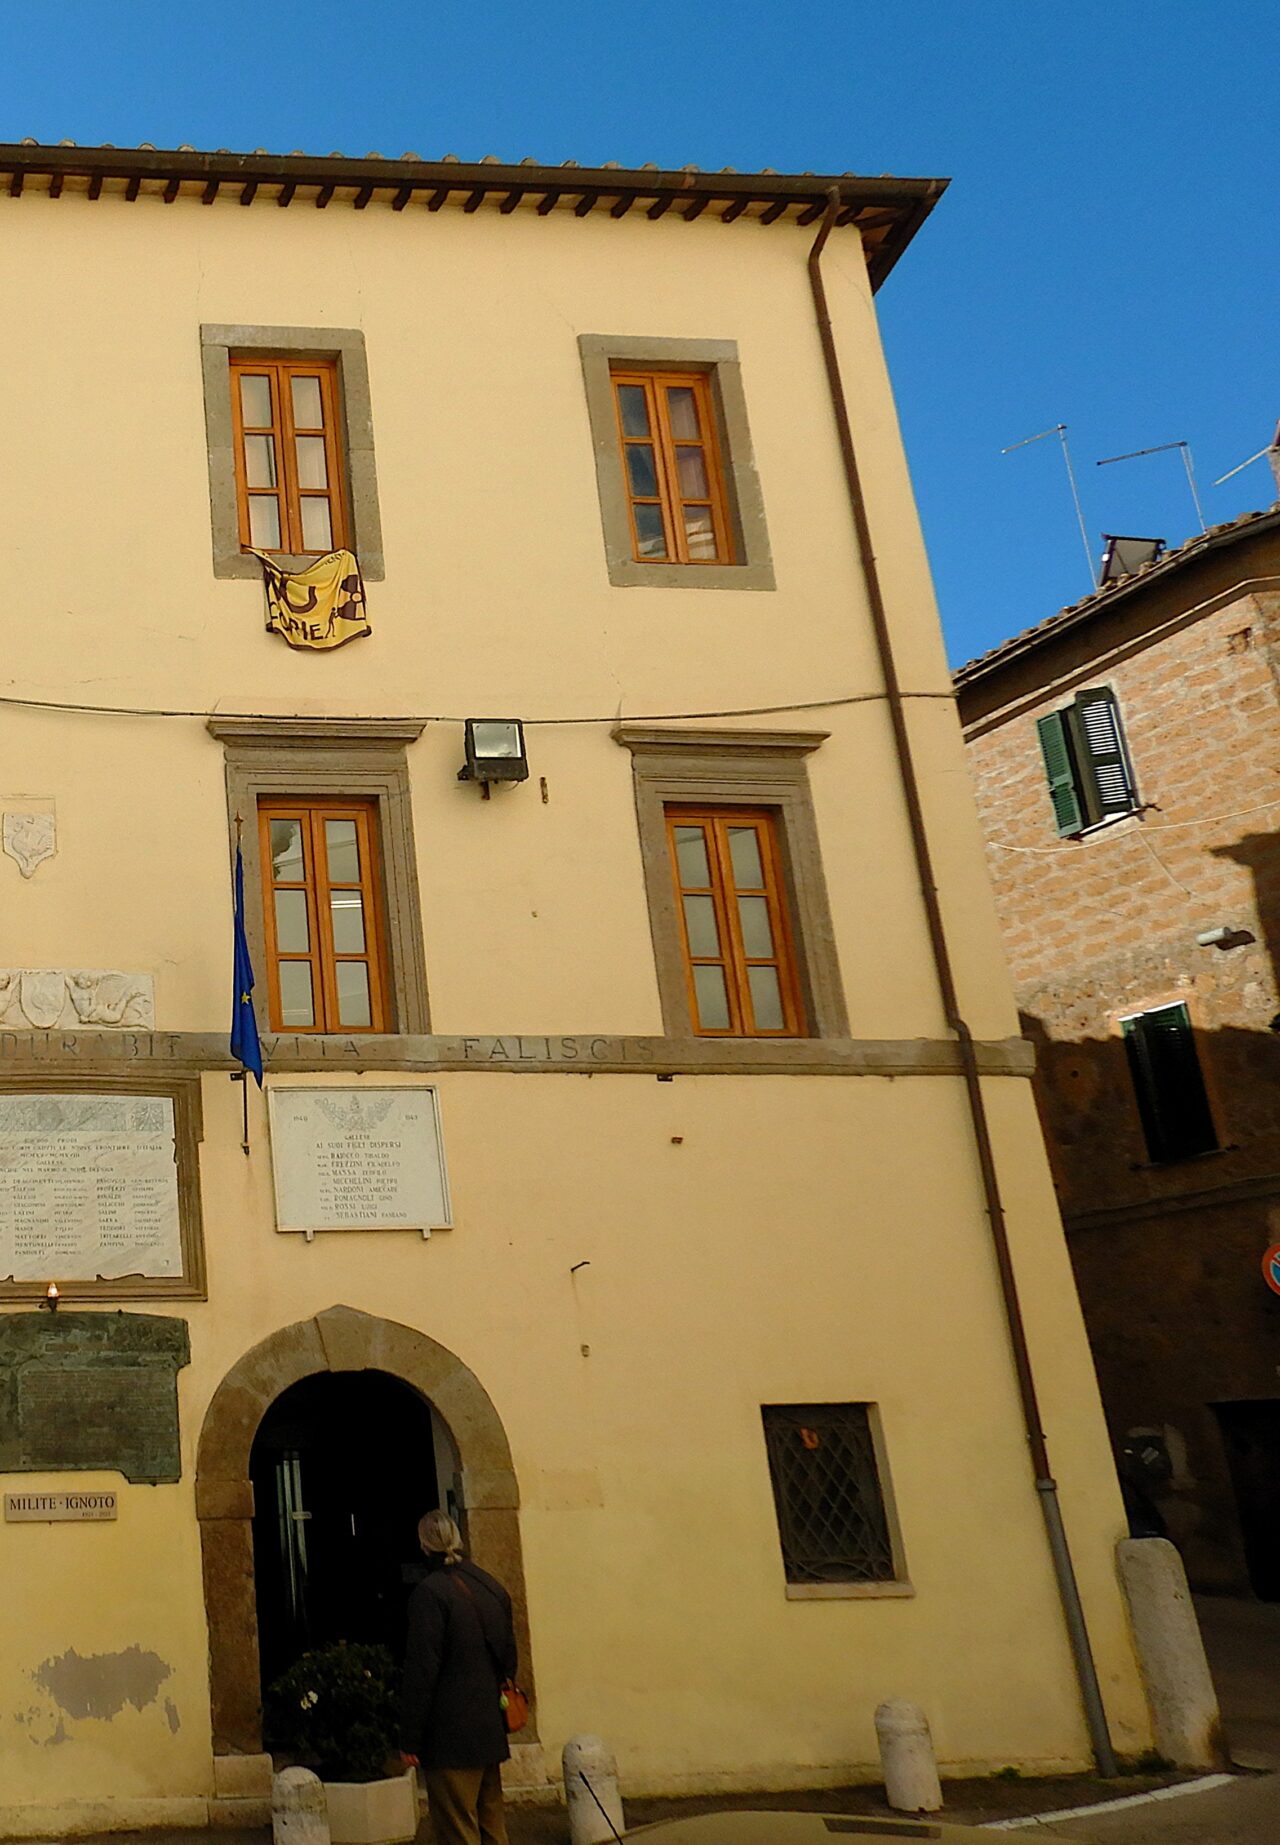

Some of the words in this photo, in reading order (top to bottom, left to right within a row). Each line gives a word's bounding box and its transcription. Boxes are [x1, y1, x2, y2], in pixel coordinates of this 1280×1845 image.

[258, 1036, 361, 1057] VITA
[462, 1038, 655, 1060] FALISCIS
[10, 1497, 57, 1510] MILITE
[65, 1496, 115, 1509] IGNOTO
